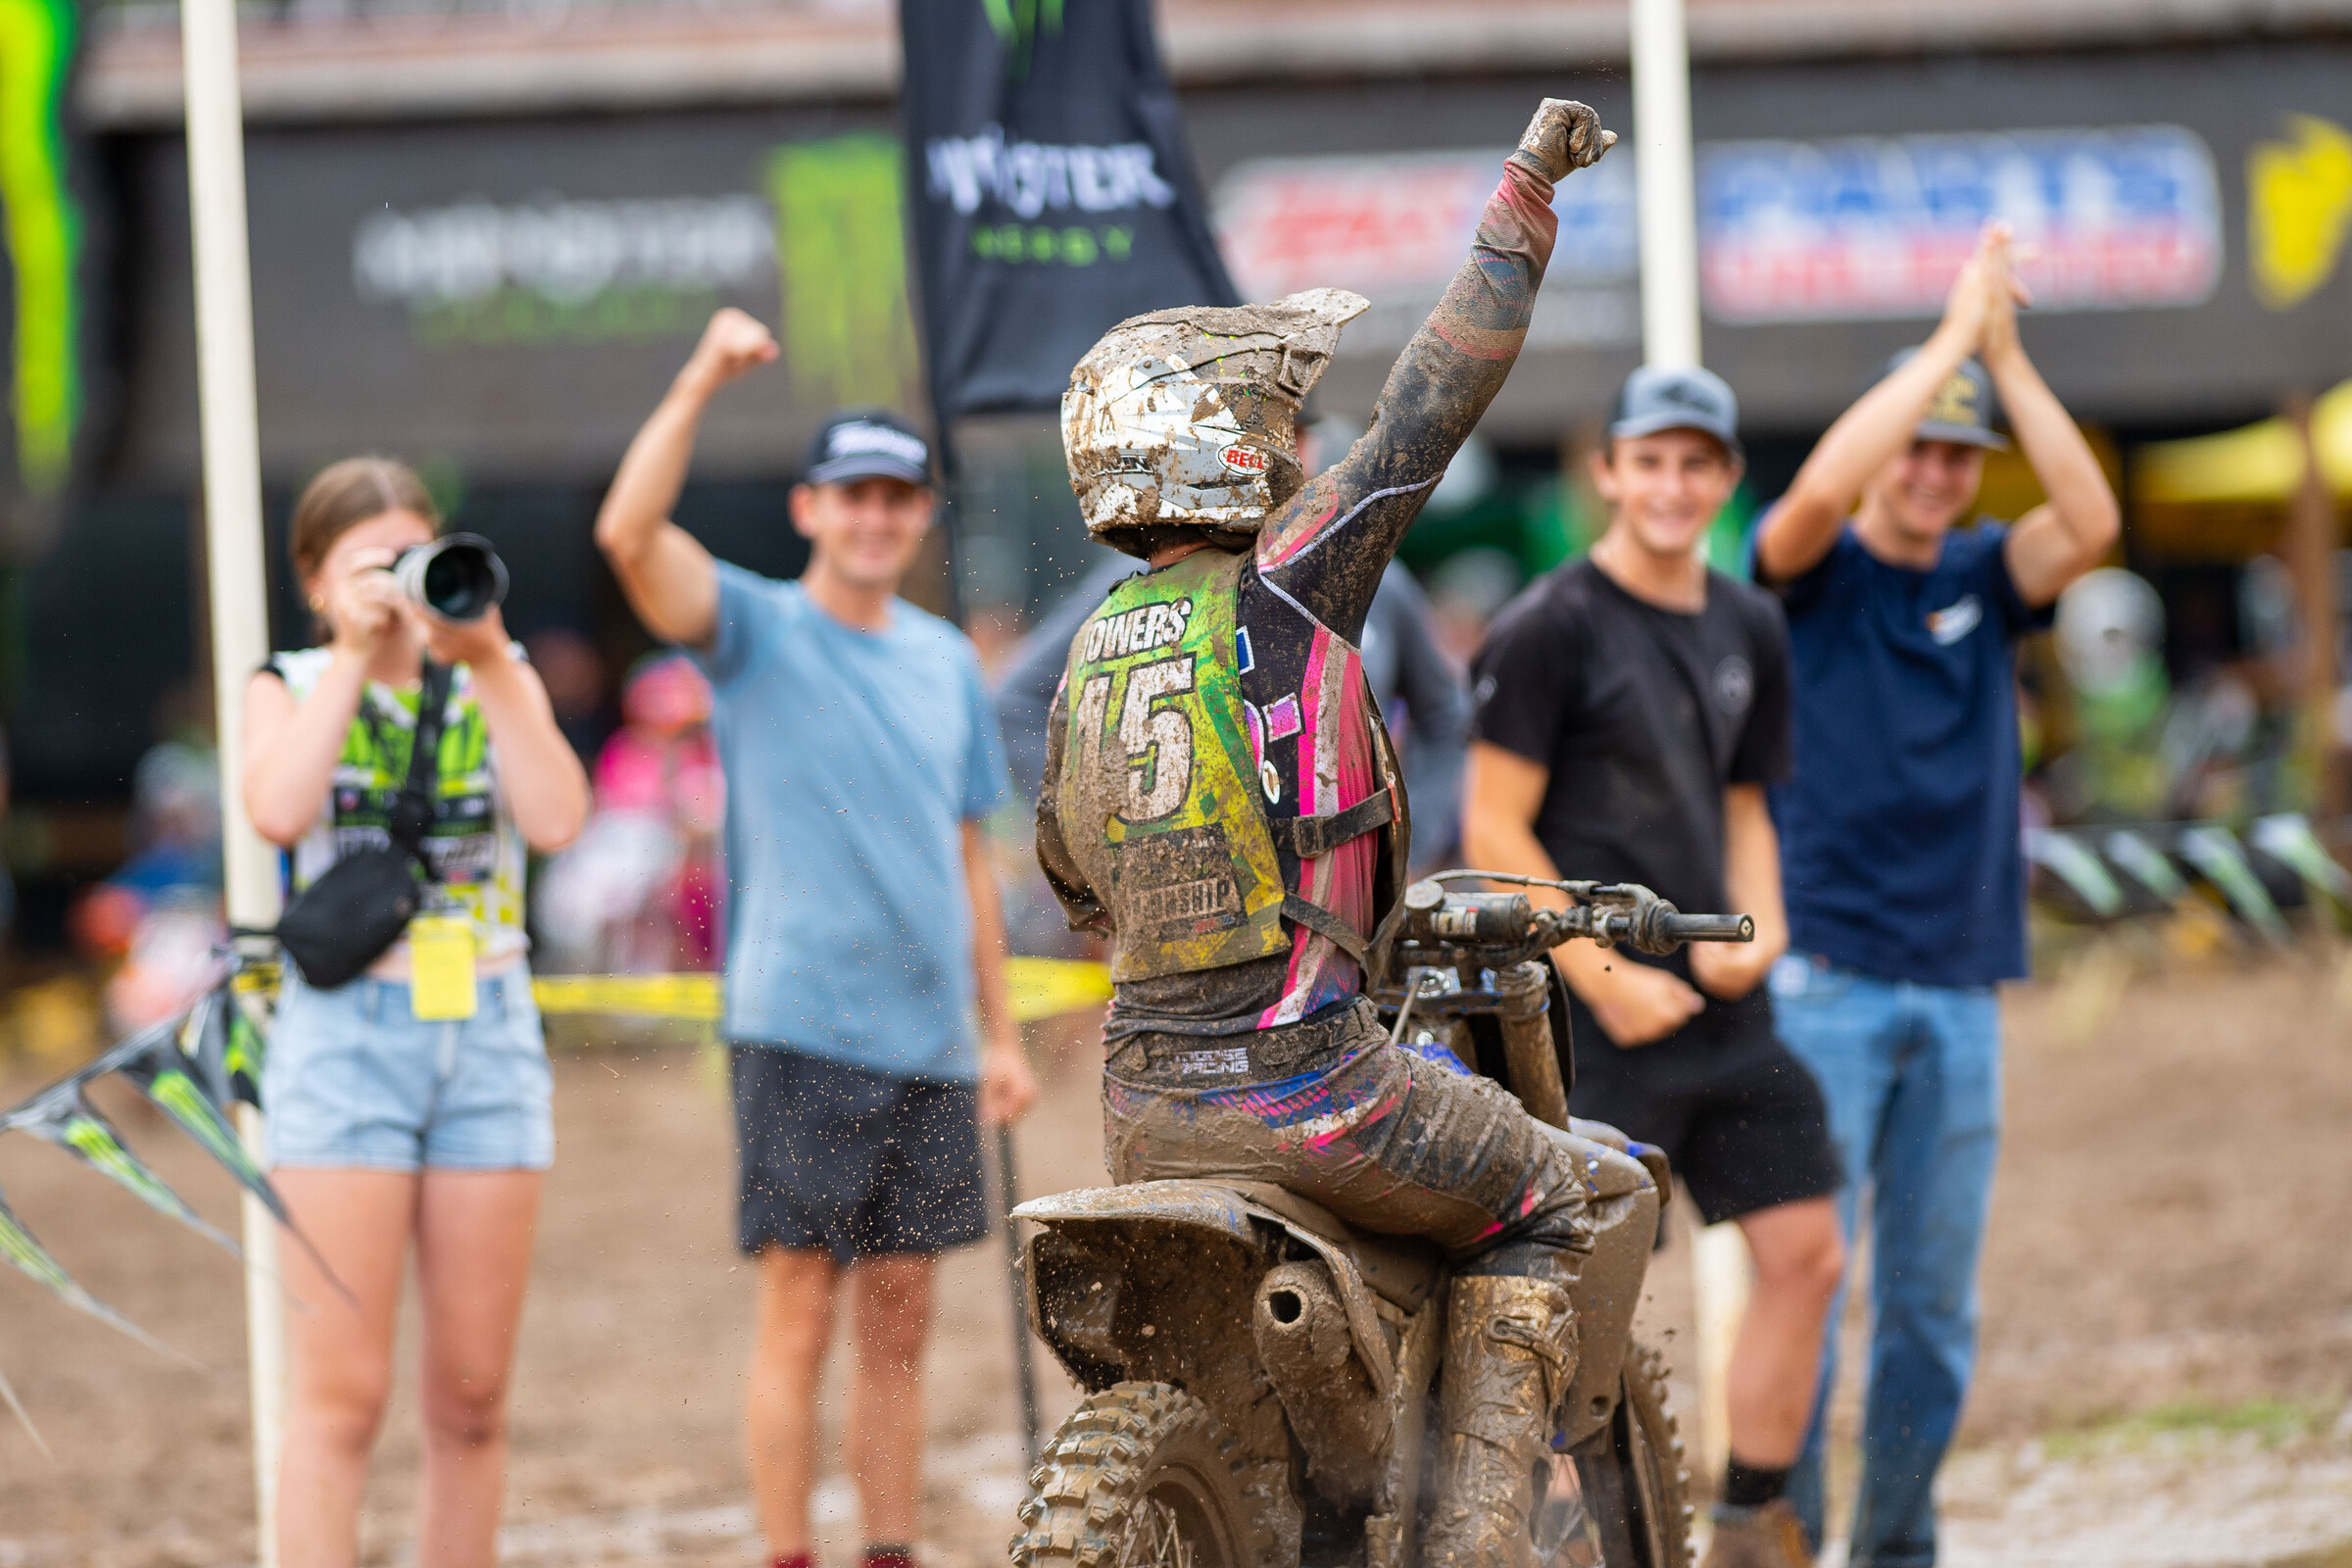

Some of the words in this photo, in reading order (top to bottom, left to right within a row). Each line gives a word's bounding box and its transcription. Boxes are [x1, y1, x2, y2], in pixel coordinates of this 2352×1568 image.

[1226, 449, 1266, 470] BELL
[1079, 597, 1193, 669] OWERS
[1074, 656, 1195, 824] 15
